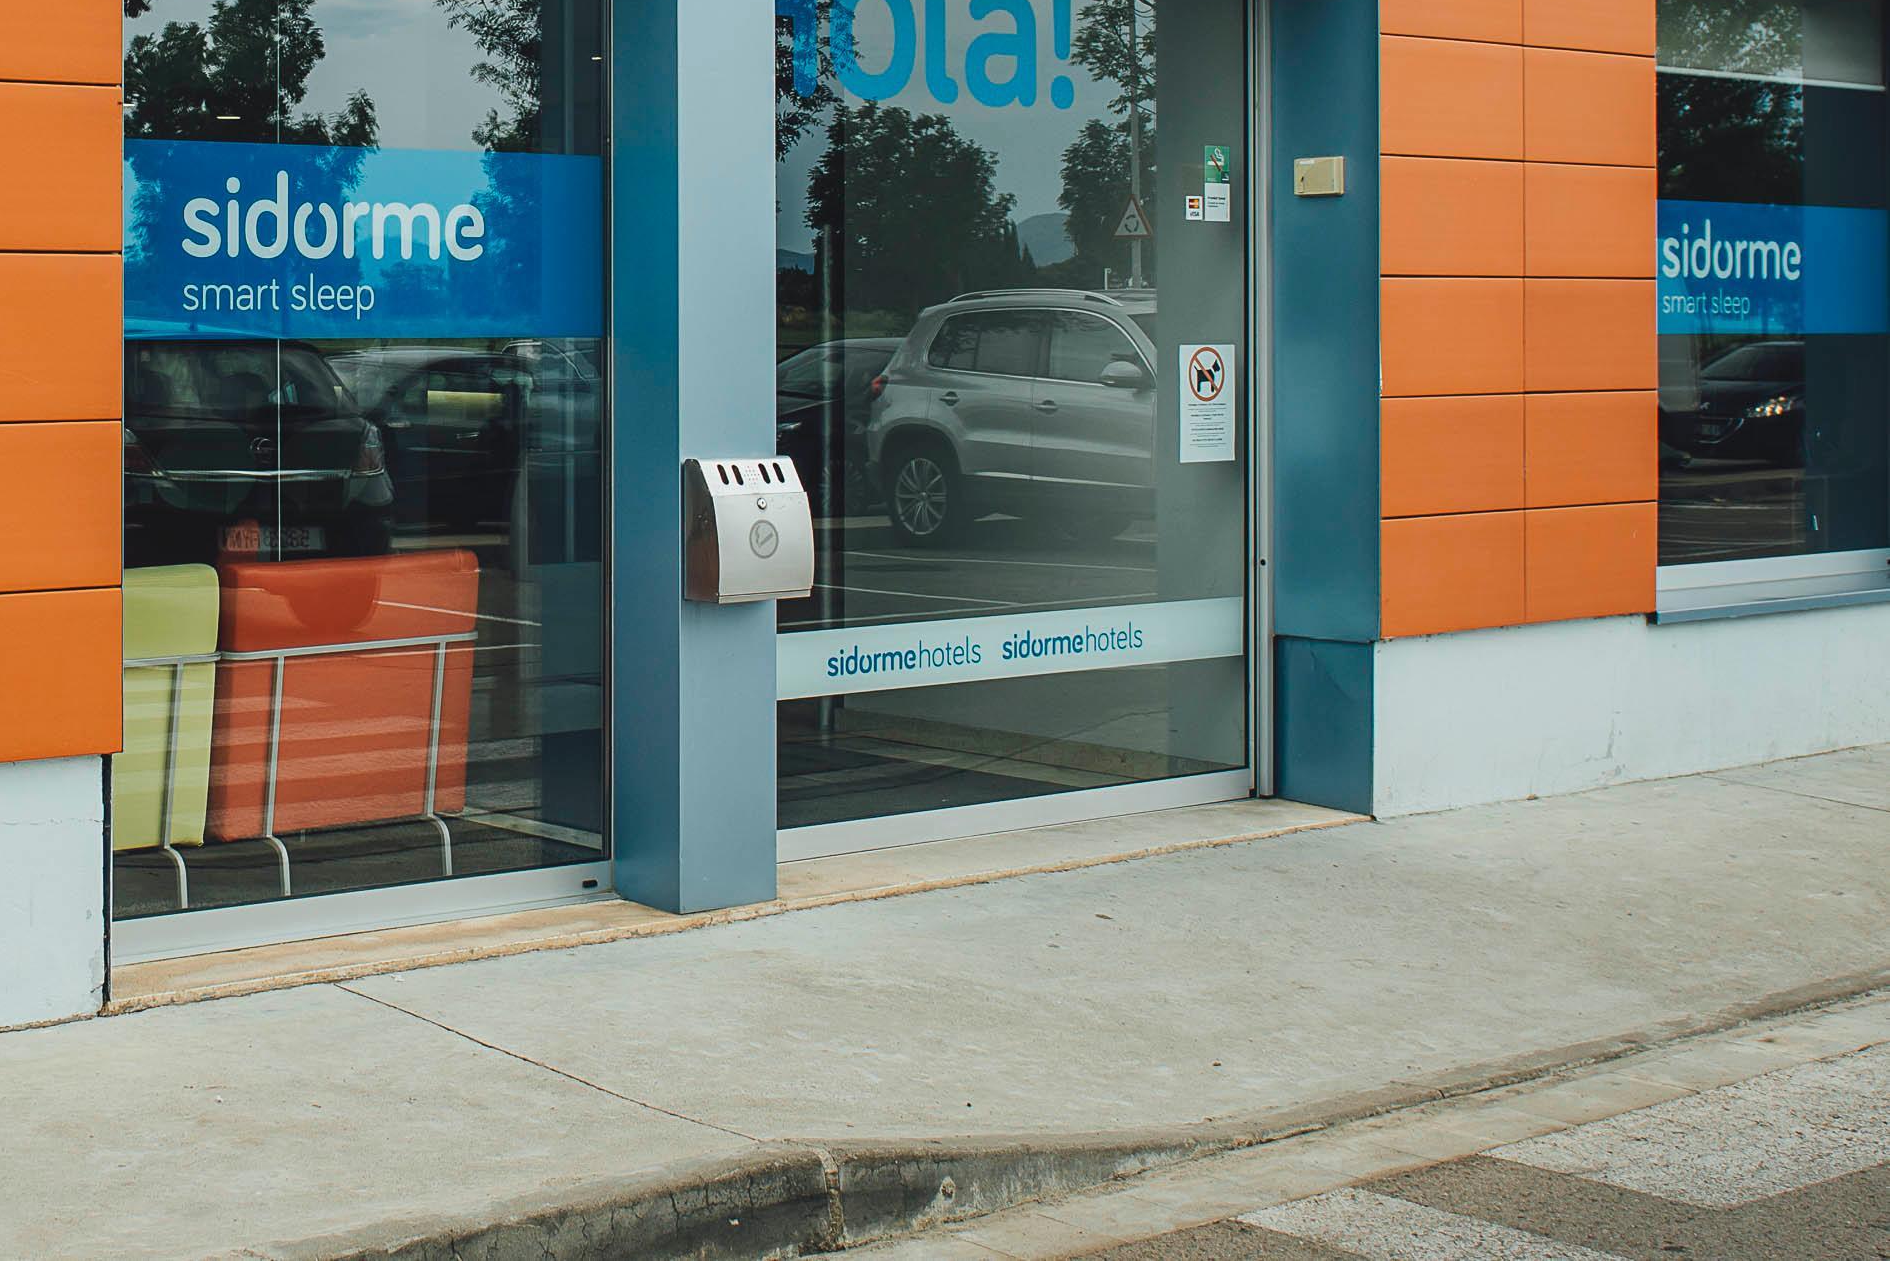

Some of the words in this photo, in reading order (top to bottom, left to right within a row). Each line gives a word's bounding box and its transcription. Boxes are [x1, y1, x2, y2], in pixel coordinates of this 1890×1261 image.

[181, 169, 485, 261] sidorme
[1661, 218, 1802, 281] sidorme
[182, 278, 280, 311] smart
[290, 273, 375, 320] sleep
[1662, 291, 1708, 315] smart
[1711, 289, 1751, 320] sleep
[826, 635, 982, 678] sidormehotels
[1002, 621, 1144, 661] sidormehotels
